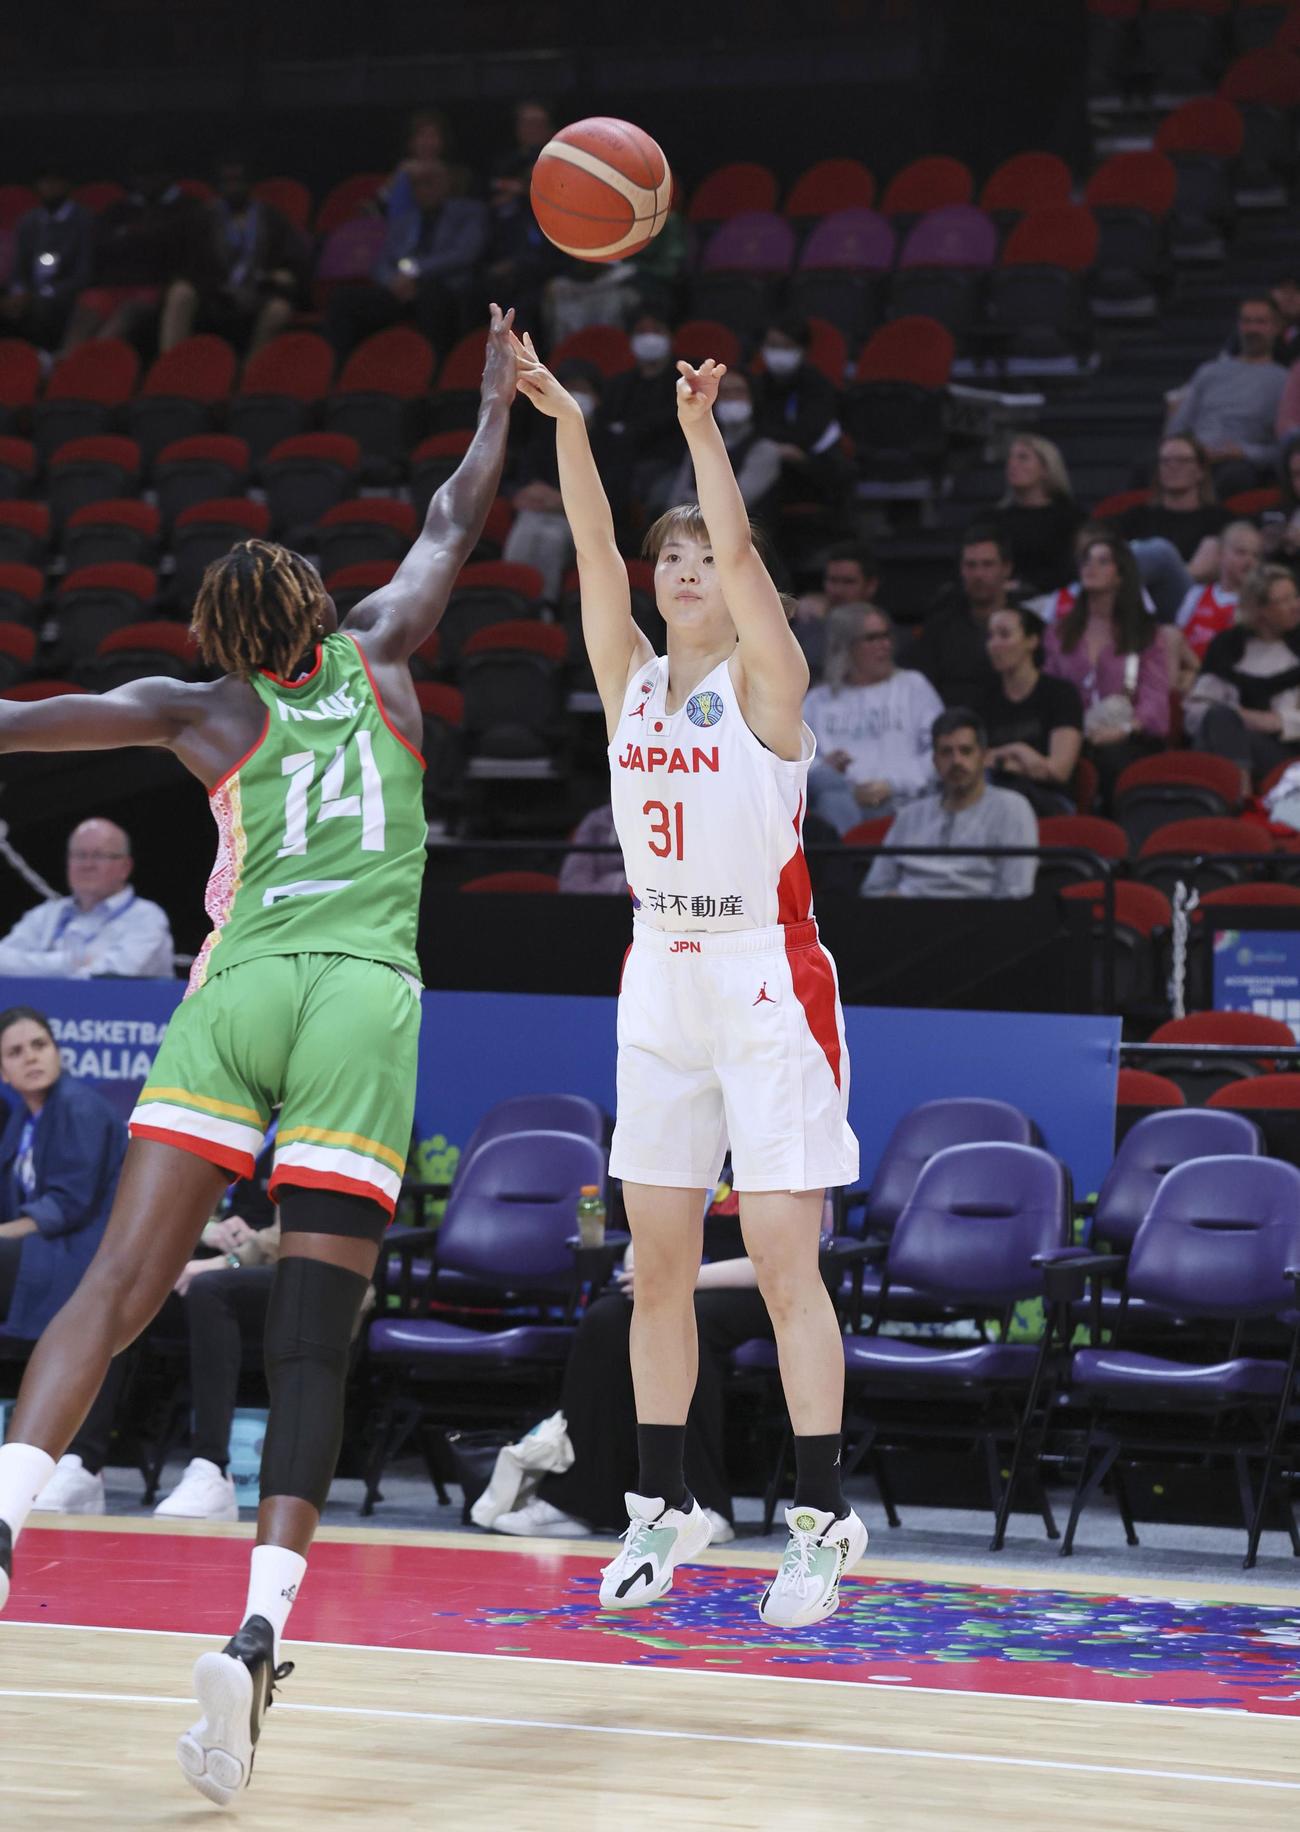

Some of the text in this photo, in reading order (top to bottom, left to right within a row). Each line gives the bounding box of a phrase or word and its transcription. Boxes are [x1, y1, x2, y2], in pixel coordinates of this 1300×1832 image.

[619, 744, 720, 773] JAPAN
[277, 730, 385, 858] 14
[643, 800, 684, 861] 31
[669, 941, 702, 953] JPN
